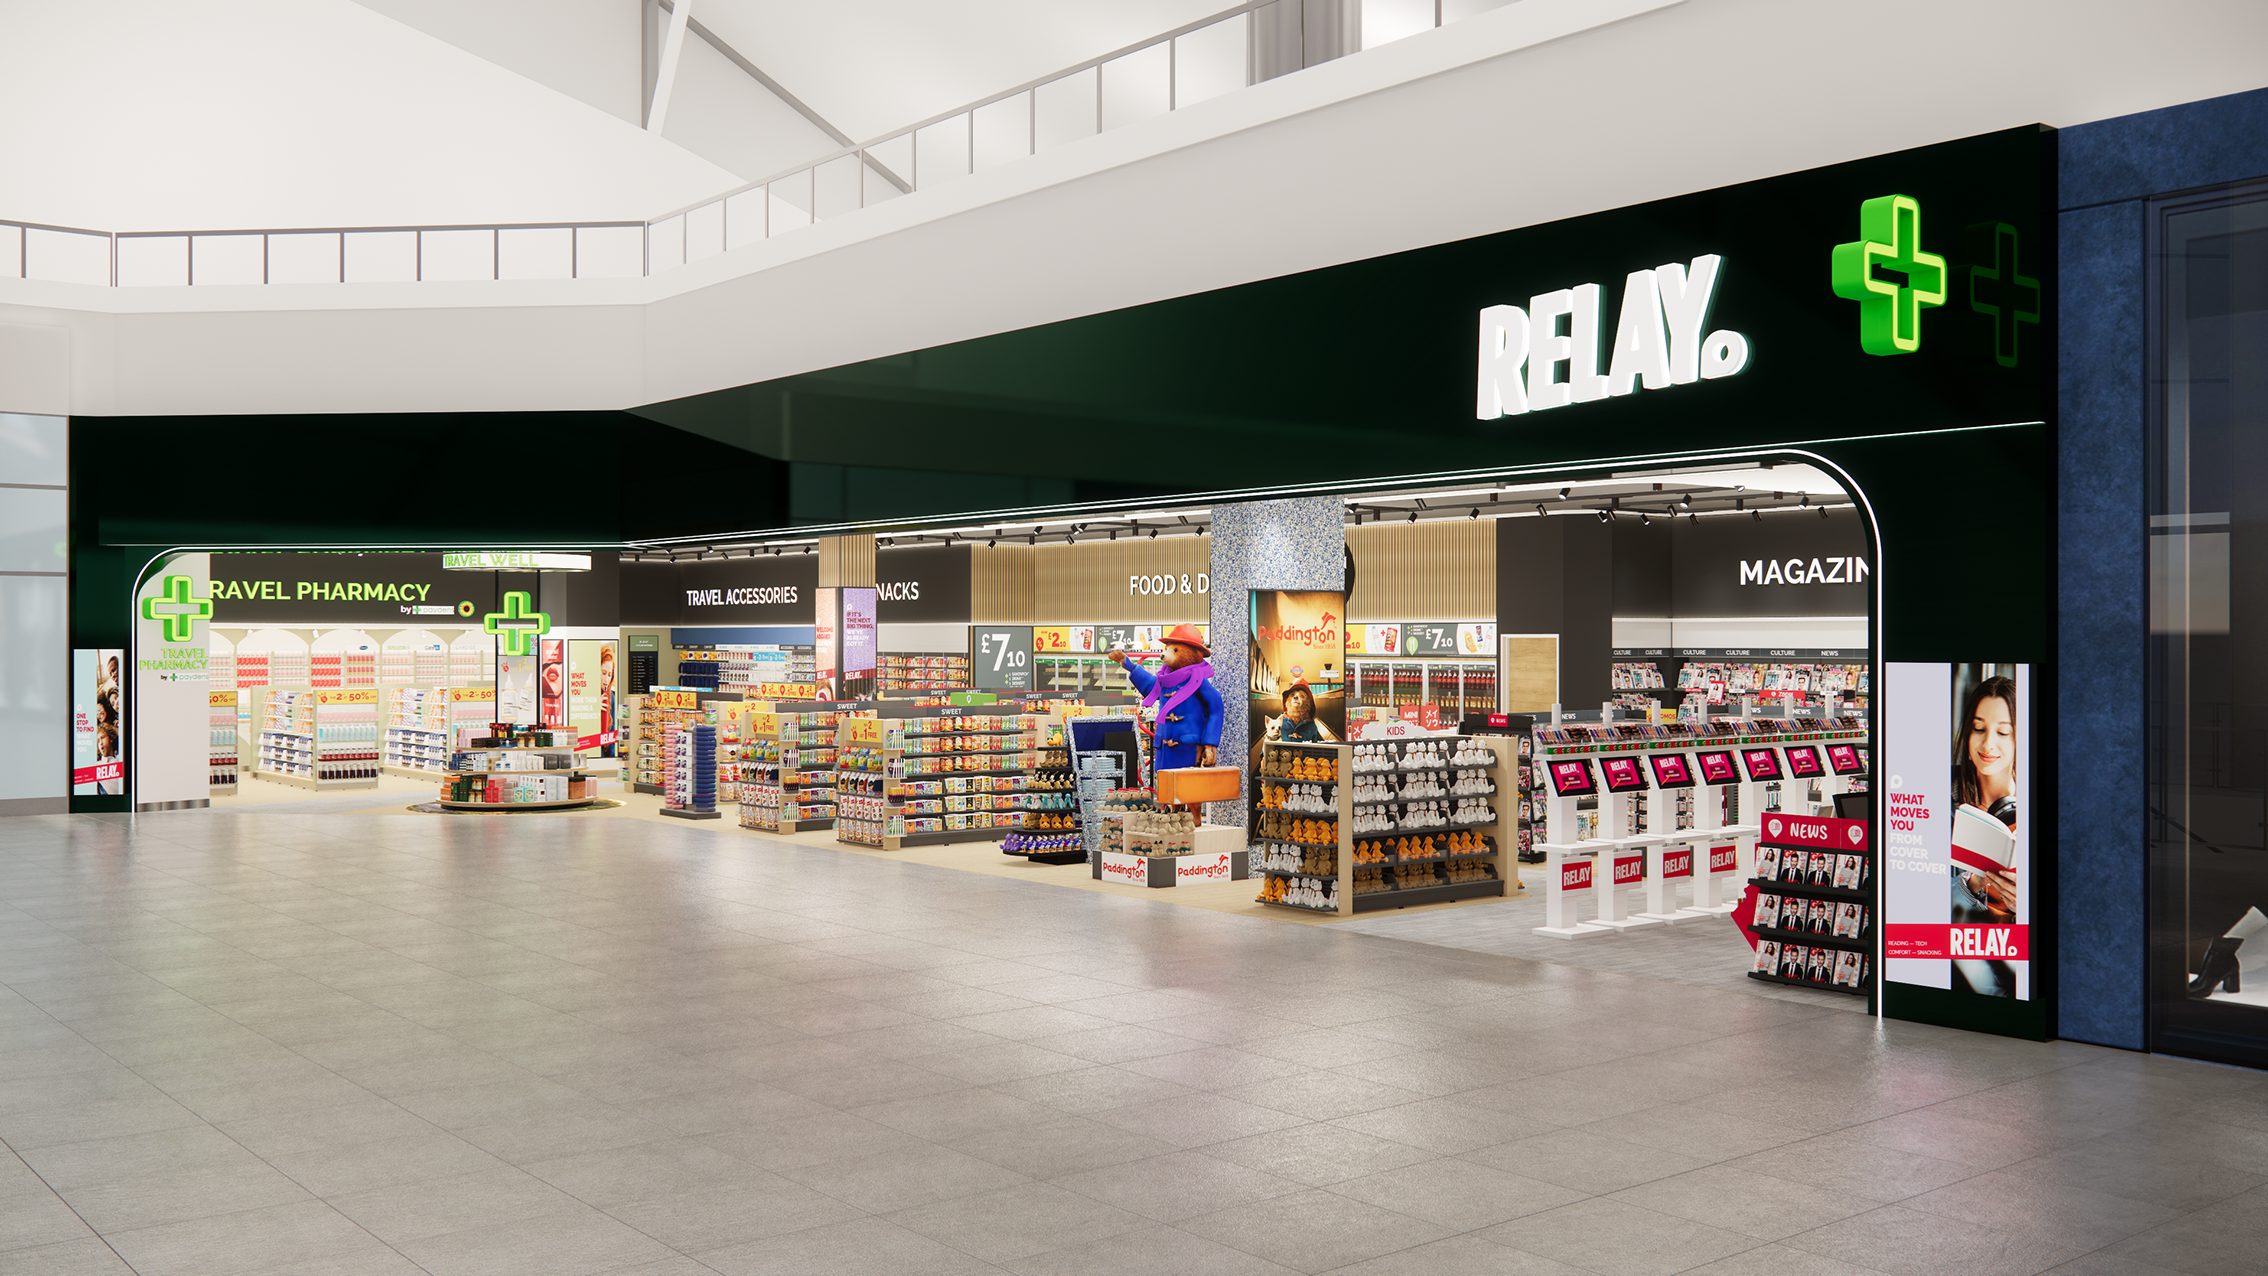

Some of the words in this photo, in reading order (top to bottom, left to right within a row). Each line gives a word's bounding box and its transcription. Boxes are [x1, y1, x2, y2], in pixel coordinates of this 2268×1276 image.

[444, 554, 486, 567] TRAVEL
[490, 554, 538, 566] WELL
[1130, 574, 1176, 596] FOOD
[1180, 573, 1194, 595] &
[297, 582, 432, 601] PHARMACY
[686, 589, 724, 606] TRAVEL
[725, 586, 798, 605] ACCESSORIES
[400, 606, 412, 615] by
[1258, 625, 1335, 646] Paddington
[161, 648, 208, 659] TRAVEL
[139, 659, 208, 670] PHARMACY
[349, 691, 370, 701] 50%
[1404, 711, 1418, 719] MINI
[1386, 726, 1405, 735] KIDS
[1890, 793, 1925, 805] WHAT
[1890, 806, 1930, 819] MOVES
[1790, 822, 1828, 840] NEWS
[1890, 819, 1914, 831] YOU
[1890, 833, 1922, 845] FROM
[1890, 846, 1928, 859] COVER
[1664, 855, 1689, 875] RELAY
[1711, 850, 1735, 869] RELAY
[1103, 861, 1145, 879] Paddington
[1178, 864, 1228, 878] Paddington
[1615, 860, 1641, 880] RELAY
[1890, 859, 1905, 871] TO
[1908, 861, 1947, 875] COVER
[1563, 866, 1591, 887] RELAY
